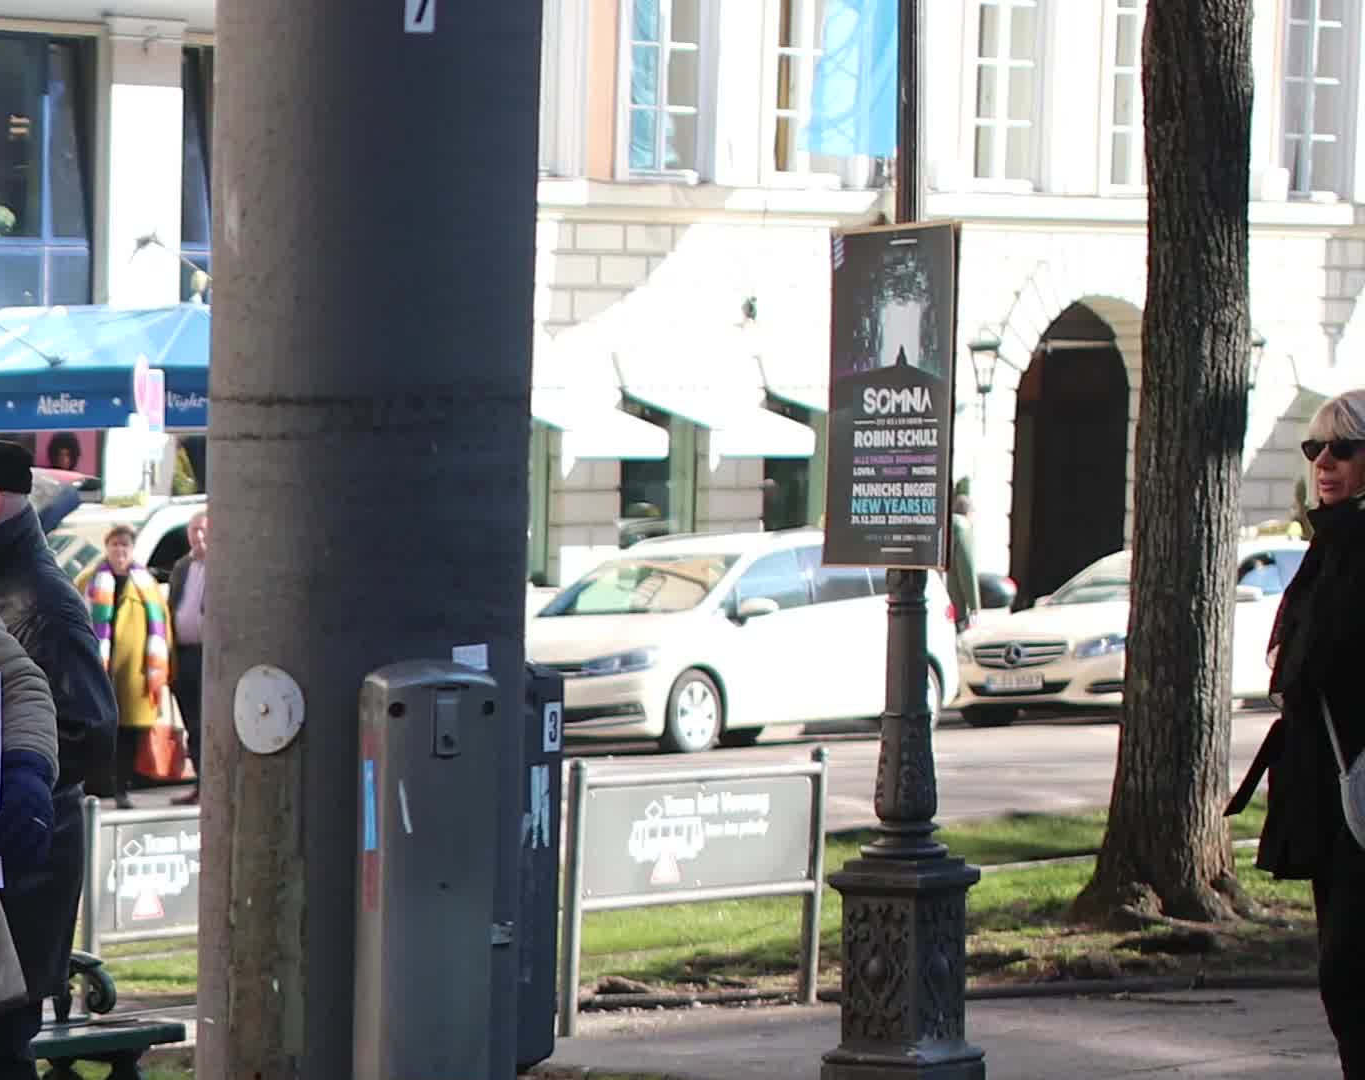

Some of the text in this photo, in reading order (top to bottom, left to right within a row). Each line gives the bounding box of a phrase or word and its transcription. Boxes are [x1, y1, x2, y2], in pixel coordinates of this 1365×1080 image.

[36, 391, 86, 416] Atelier
[854, 428, 938, 448] ROBIN SCHULZ
[852, 482, 937, 497] MUNICHS BIGGEST
[851, 498, 882, 515] NEW
[883, 498, 920, 514] YEARS
